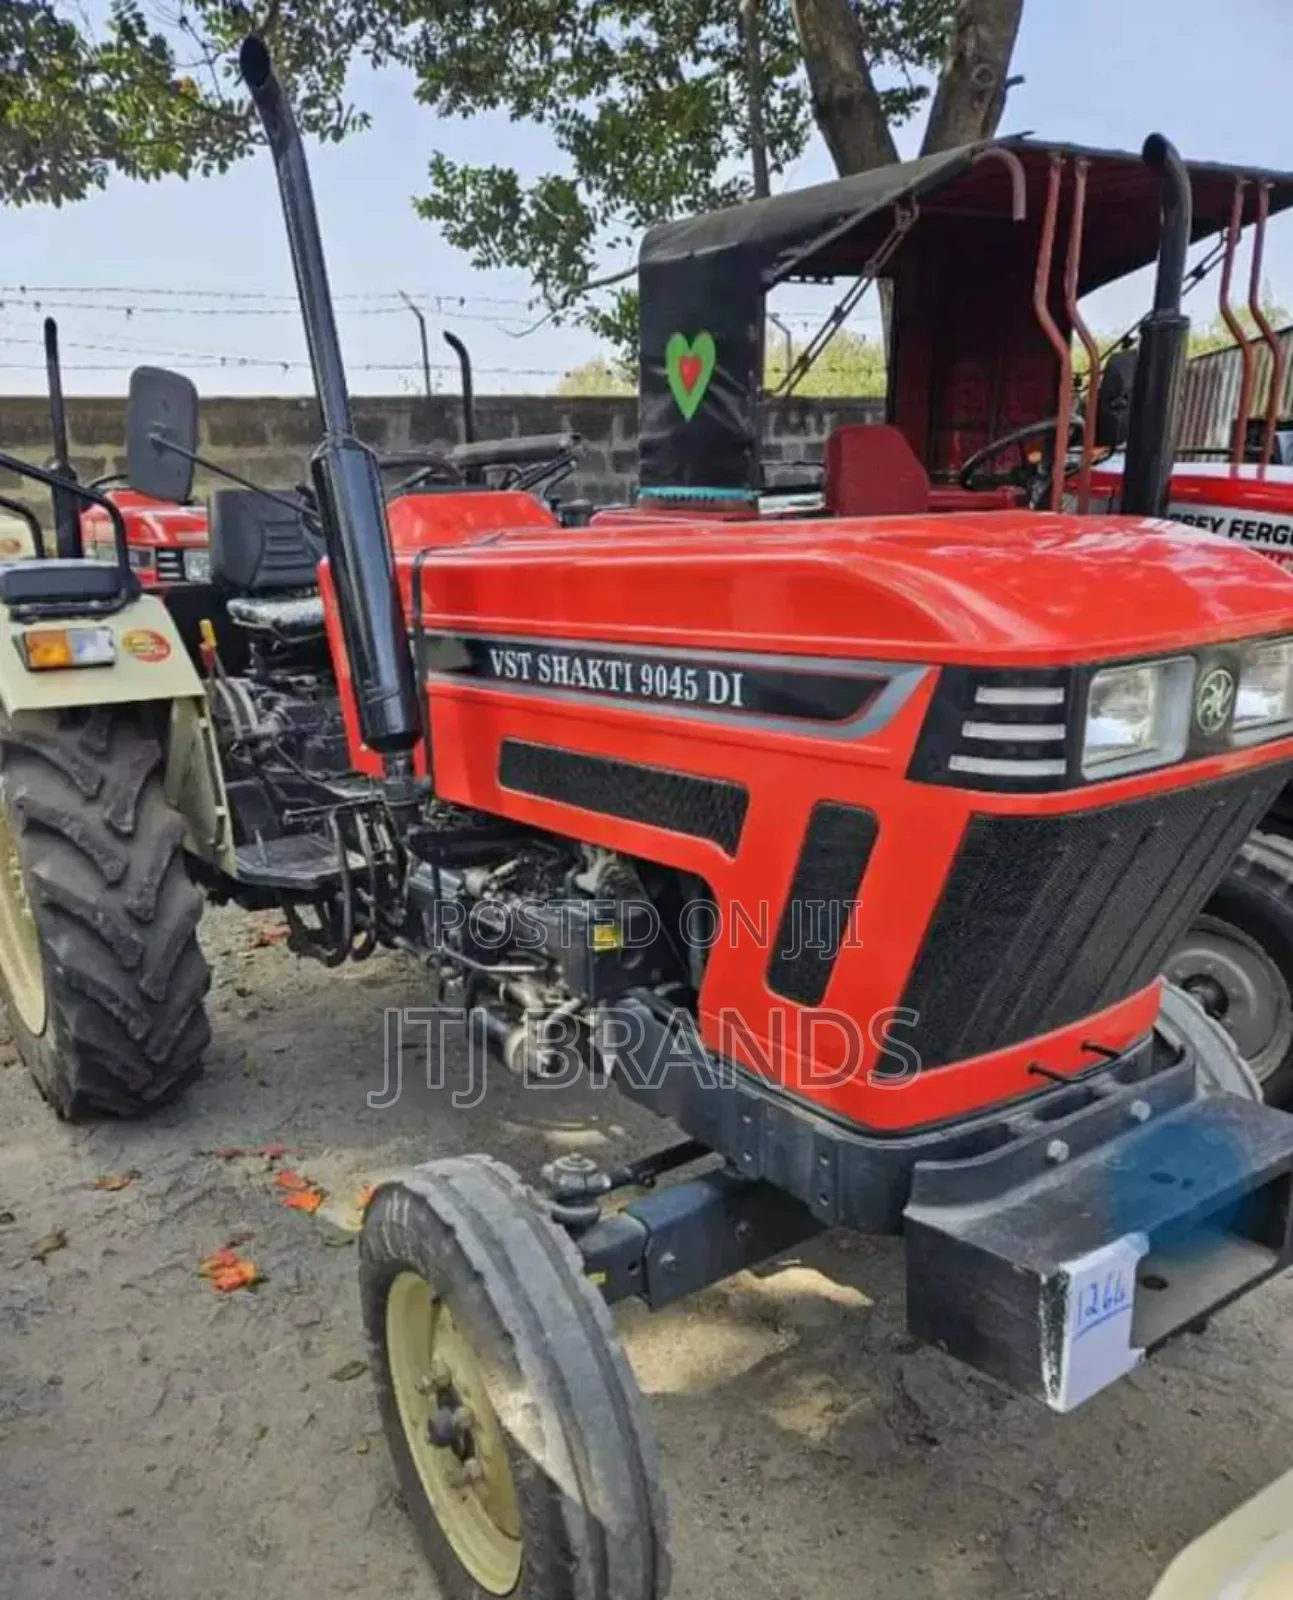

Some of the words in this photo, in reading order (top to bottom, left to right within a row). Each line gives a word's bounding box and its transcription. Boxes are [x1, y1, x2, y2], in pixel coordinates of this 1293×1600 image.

[1228, 518, 1293, 546] FERG
[490, 648, 533, 680] VST
[537, 653, 633, 693] SHAKTI
[640, 664, 698, 701] 9045
[707, 670, 744, 706] DI
